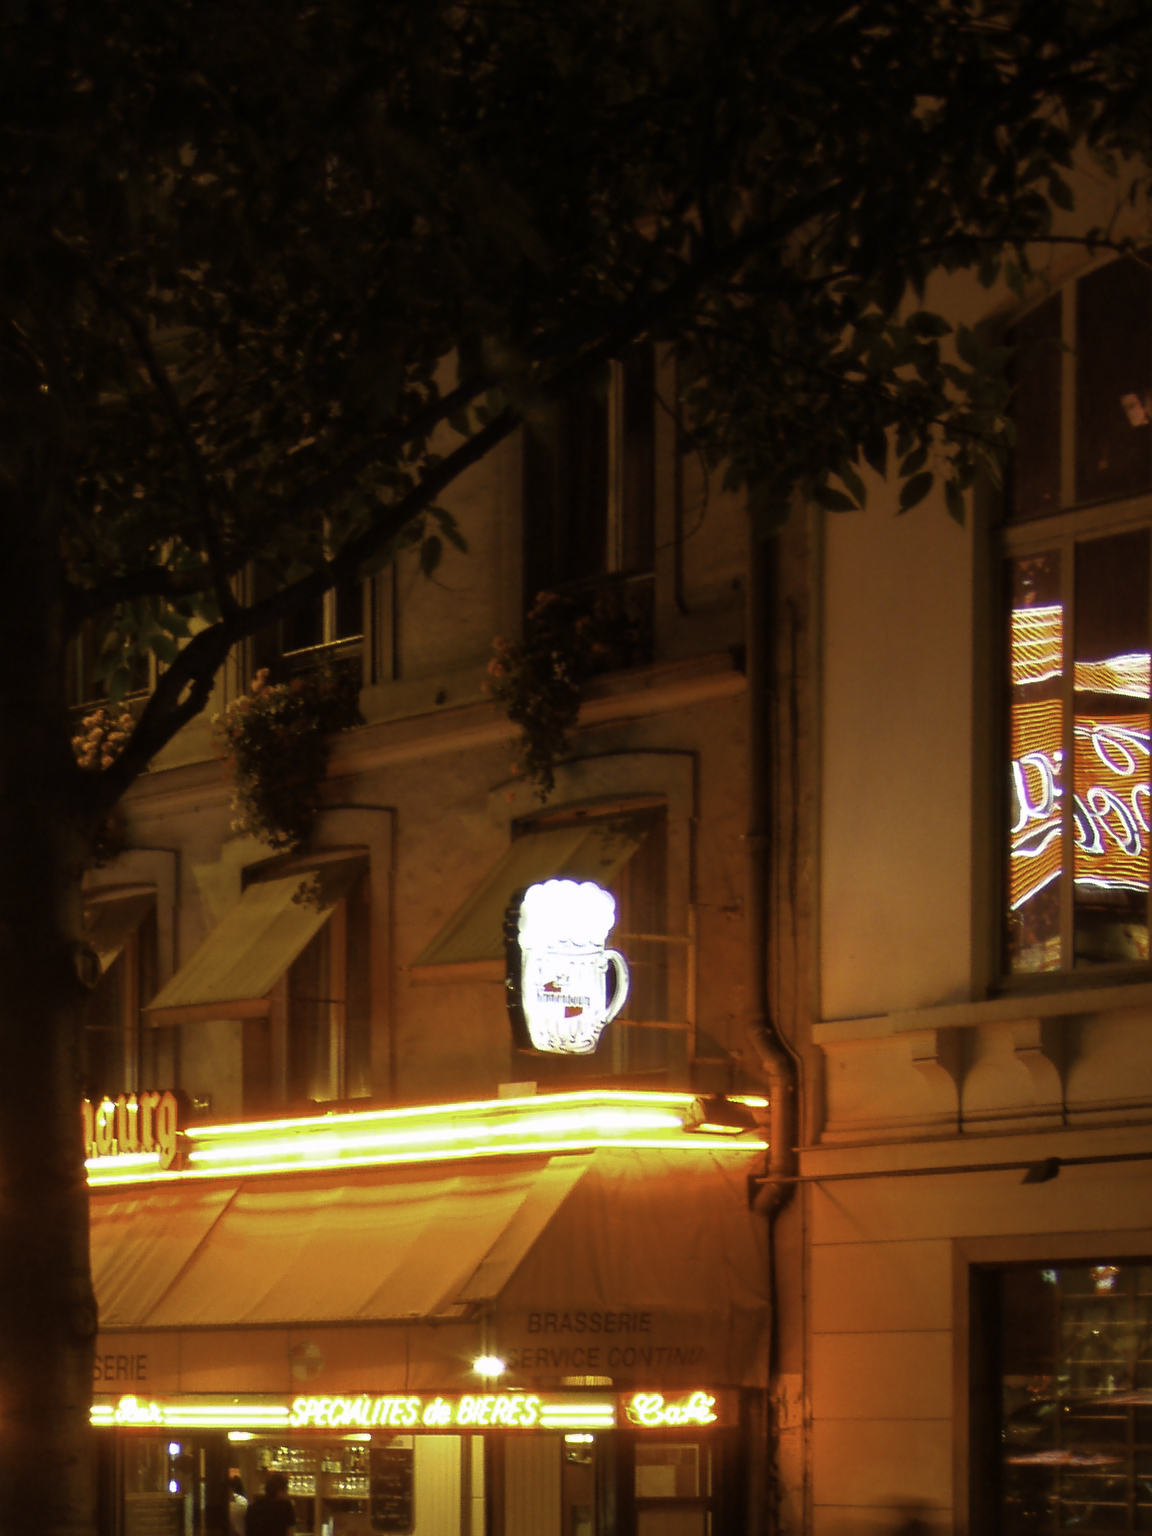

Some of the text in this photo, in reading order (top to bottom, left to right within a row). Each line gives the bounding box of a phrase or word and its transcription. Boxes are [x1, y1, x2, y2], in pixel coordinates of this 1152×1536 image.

[528, 1312, 652, 1334] BRASSERIE
[93, 1354, 148, 1382] SERIE
[506, 1347, 600, 1369] SERVICE
[608, 1346, 705, 1368] CONTINU
[289, 1394, 541, 1427] SPECIALITES de BIERES
